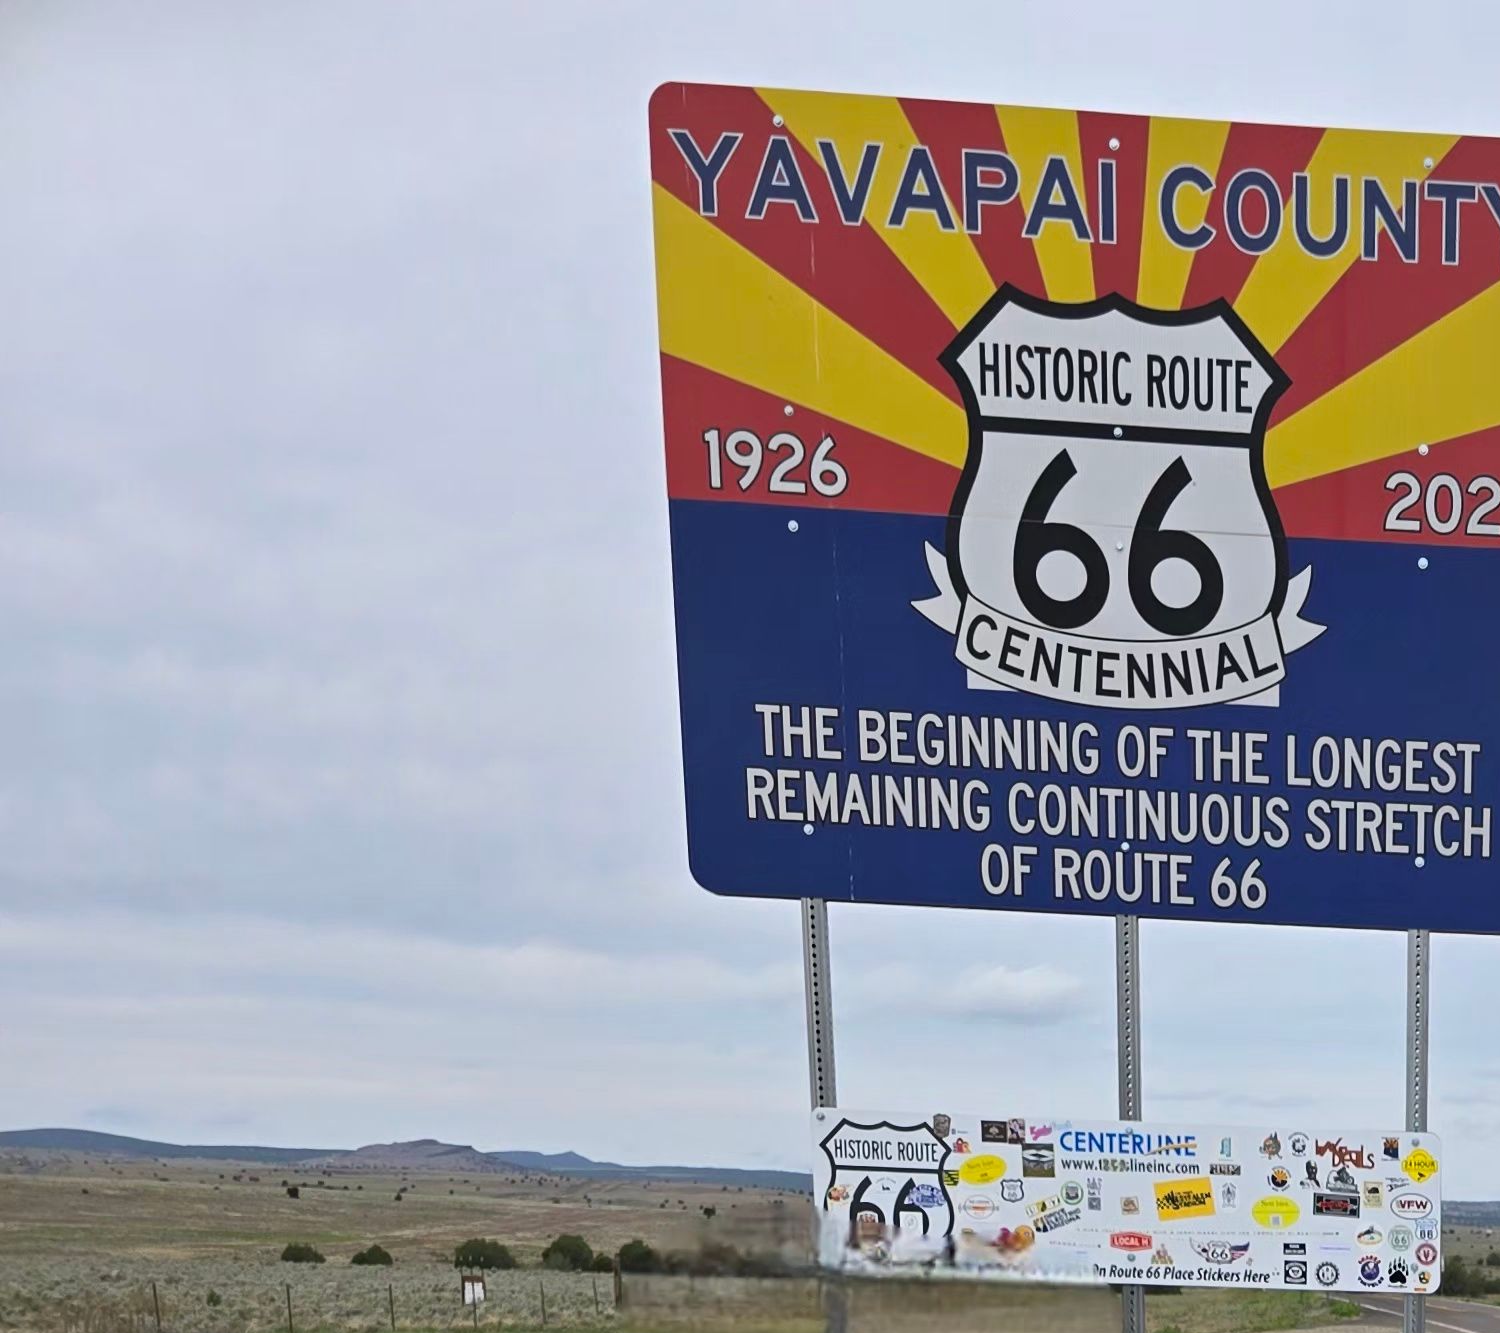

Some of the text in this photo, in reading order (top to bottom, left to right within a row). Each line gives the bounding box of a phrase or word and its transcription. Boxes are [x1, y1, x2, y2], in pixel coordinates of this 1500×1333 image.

[667, 127, 1118, 246] YAVAPAI
[979, 342, 1254, 414] HISTORIC ROUTE
[702, 427, 849, 497] 1926
[1012, 448, 1225, 636] 66
[964, 612, 1280, 700] CENTENNIAL
[755, 704, 1481, 796] THE BEGINNING OF THE LONGEST
[746, 768, 1493, 860] REMAINING CONTINUOUS STRETCH
[980, 845, 1268, 910] OF ROUTE 66
[834, 1138, 939, 1162] HISTORIC ROUTE
[1413, 1160, 1435, 1169] HOUR
[1400, 1200, 1427, 1210] VFW
[1109, 1264, 1144, 1278] Route
[1146, 1266, 1161, 1279] 66
[1163, 1266, 1194, 1280] Place
[1196, 1267, 1240, 1282] Stickers
[1243, 1269, 1271, 1283] Here
[1211, 1248, 1228, 1260] 66
